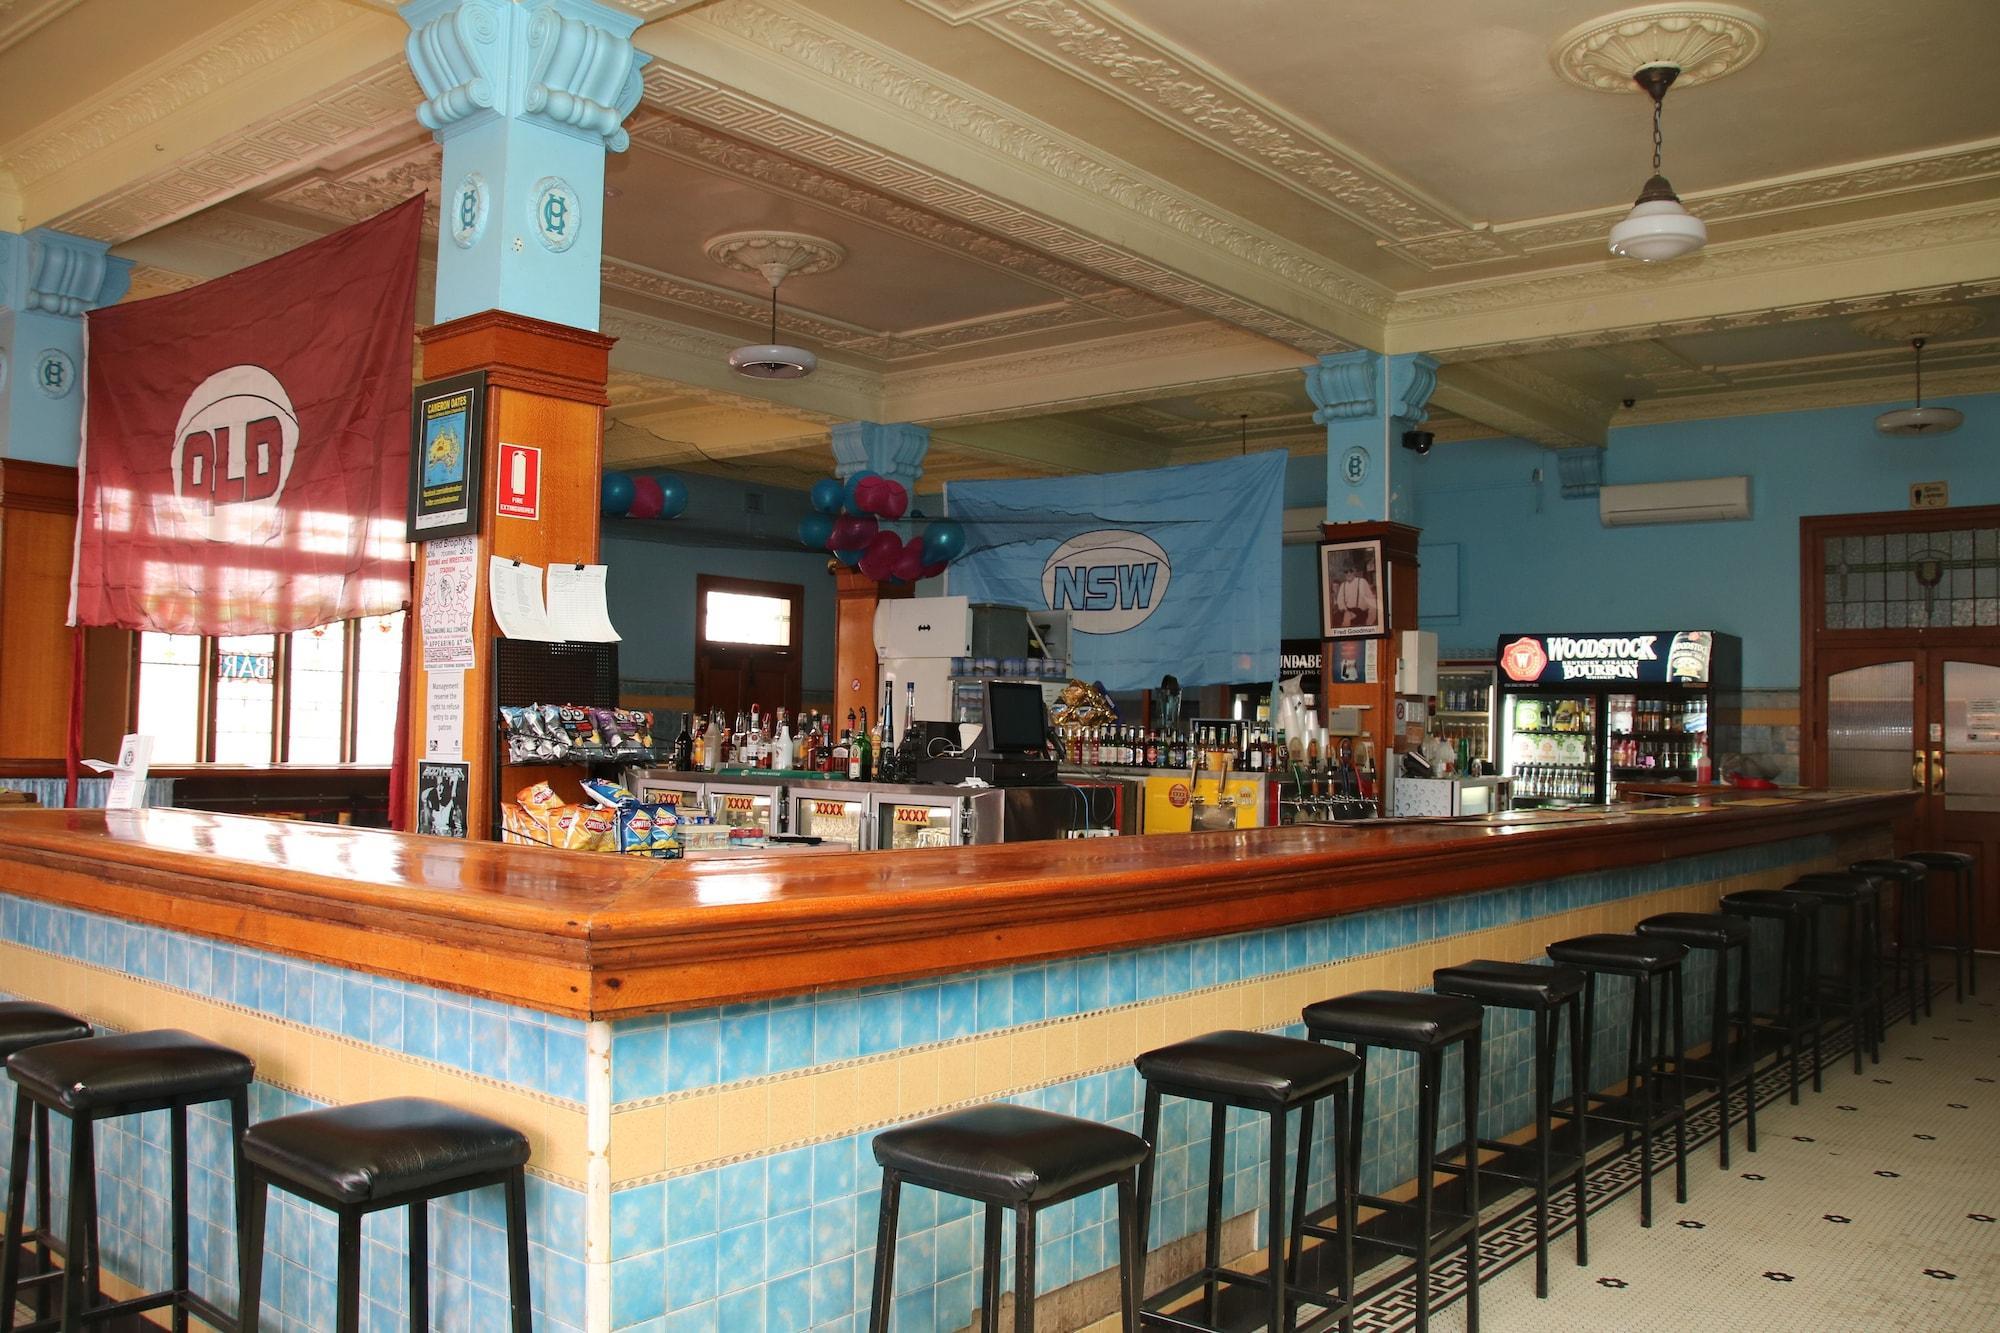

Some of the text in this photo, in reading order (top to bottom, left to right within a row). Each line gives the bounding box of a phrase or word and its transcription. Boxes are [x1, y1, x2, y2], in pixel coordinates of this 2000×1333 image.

[428, 400, 450, 414] CAMERON
[450, 395, 467, 409] OATES
[180, 415, 284, 514] QLD
[511, 496, 524, 504] FIRE
[500, 503, 535, 514] EXTINGUISHER
[430, 540, 442, 549] Fred
[1053, 562, 1158, 611] NSW
[1547, 636, 1658, 661] WOODSTOCK
[1562, 664, 1639, 680] BOURBON
[727, 797, 752, 809] XXXX
[816, 802, 843, 816] XXXX
[897, 809, 928, 822] XXXX
